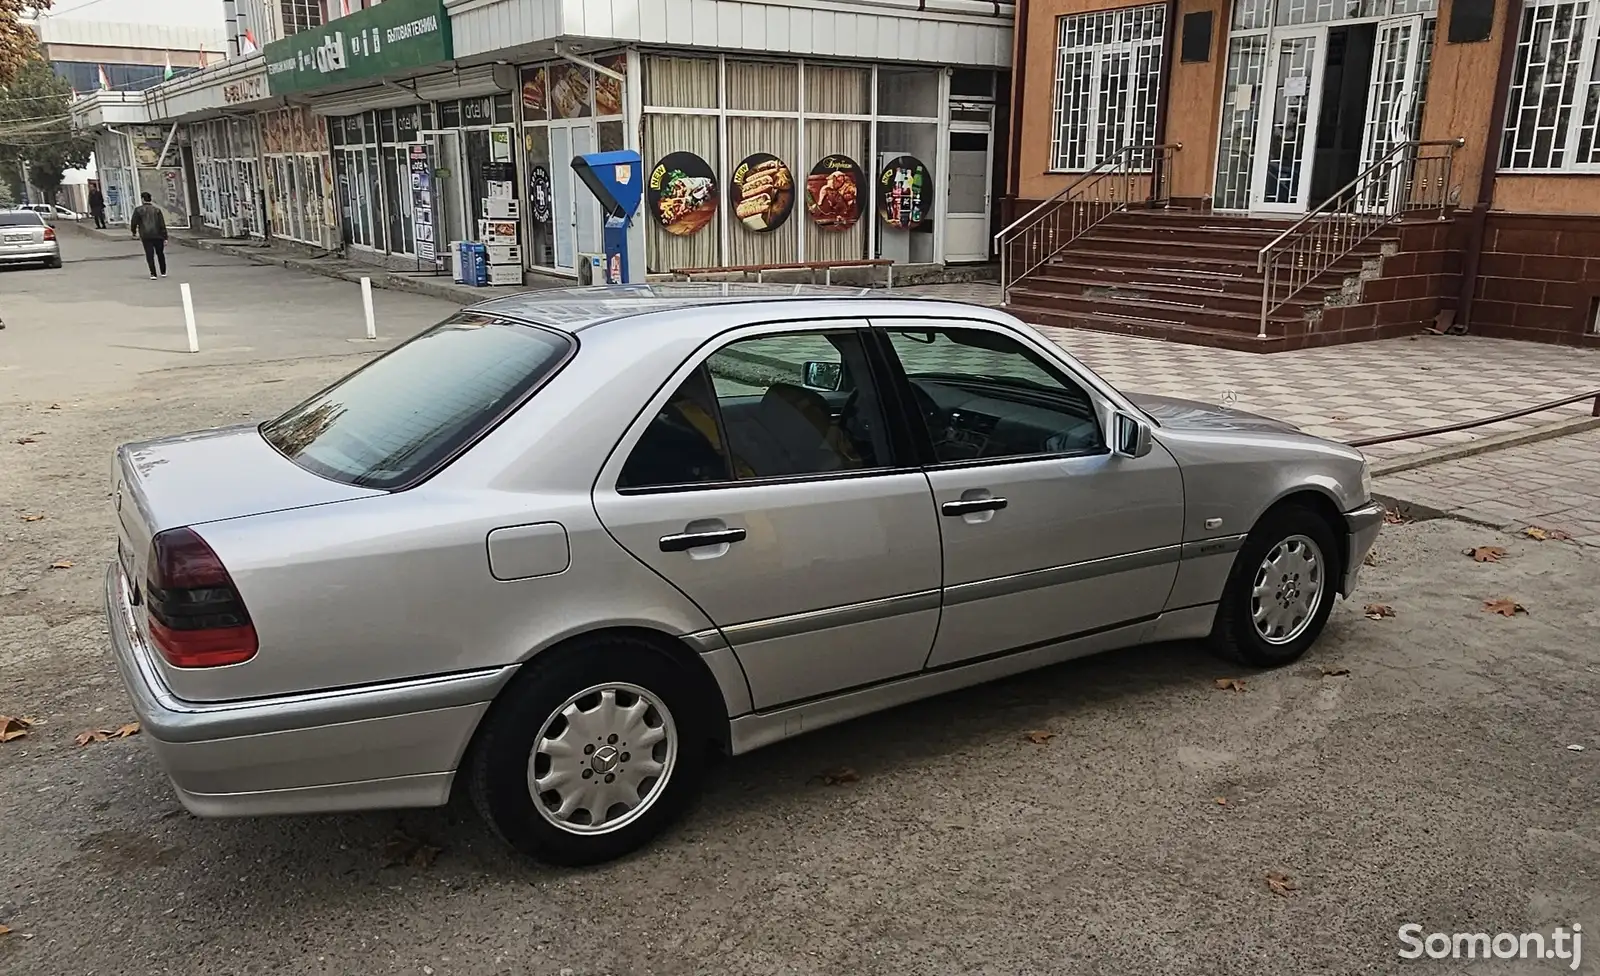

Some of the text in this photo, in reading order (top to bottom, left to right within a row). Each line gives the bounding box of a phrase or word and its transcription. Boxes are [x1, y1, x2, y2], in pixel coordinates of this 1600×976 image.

[387, 15, 437, 43] БЫТОВАЯ ТЕХНИКА
[651, 165, 665, 187] NEW
[735, 164, 748, 182] NEW
